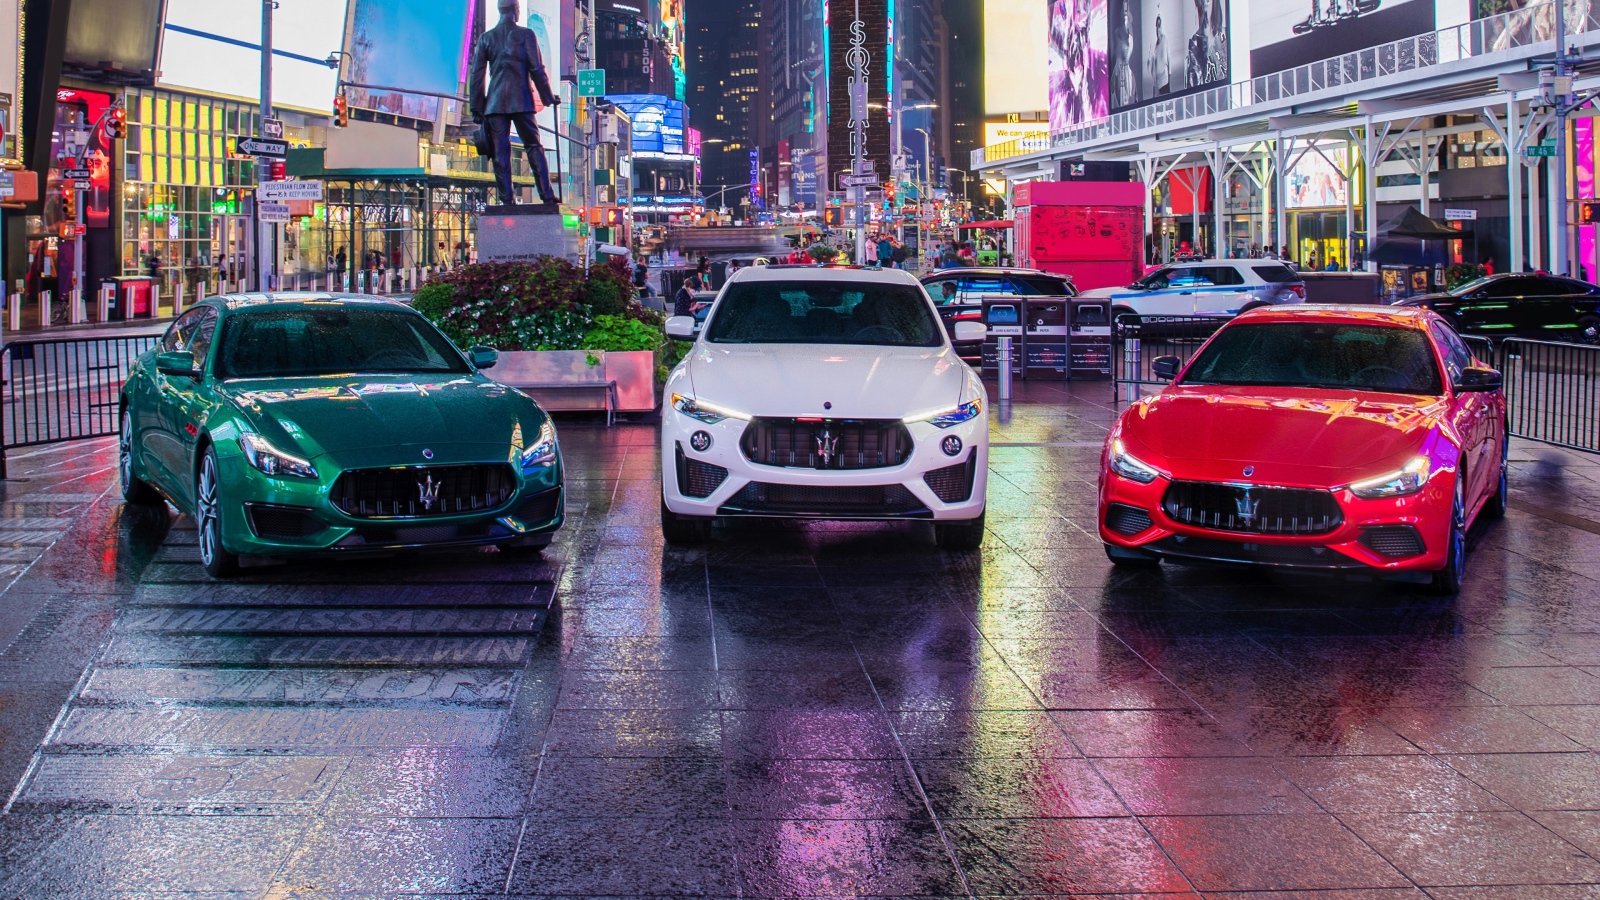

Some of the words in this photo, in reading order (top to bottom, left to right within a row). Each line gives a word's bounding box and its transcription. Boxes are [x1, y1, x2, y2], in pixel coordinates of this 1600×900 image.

[642, 39, 650, 74] 1500
[846, 20, 871, 175] SQR
[244, 142, 259, 151] ONE
[265, 144, 282, 153] WAY
[1528, 147, 1535, 155] W
[1538, 147, 1548, 155] 46
[127, 610, 537, 630] AMBASSADOR
[270, 638, 525, 661] GERSHWIN
